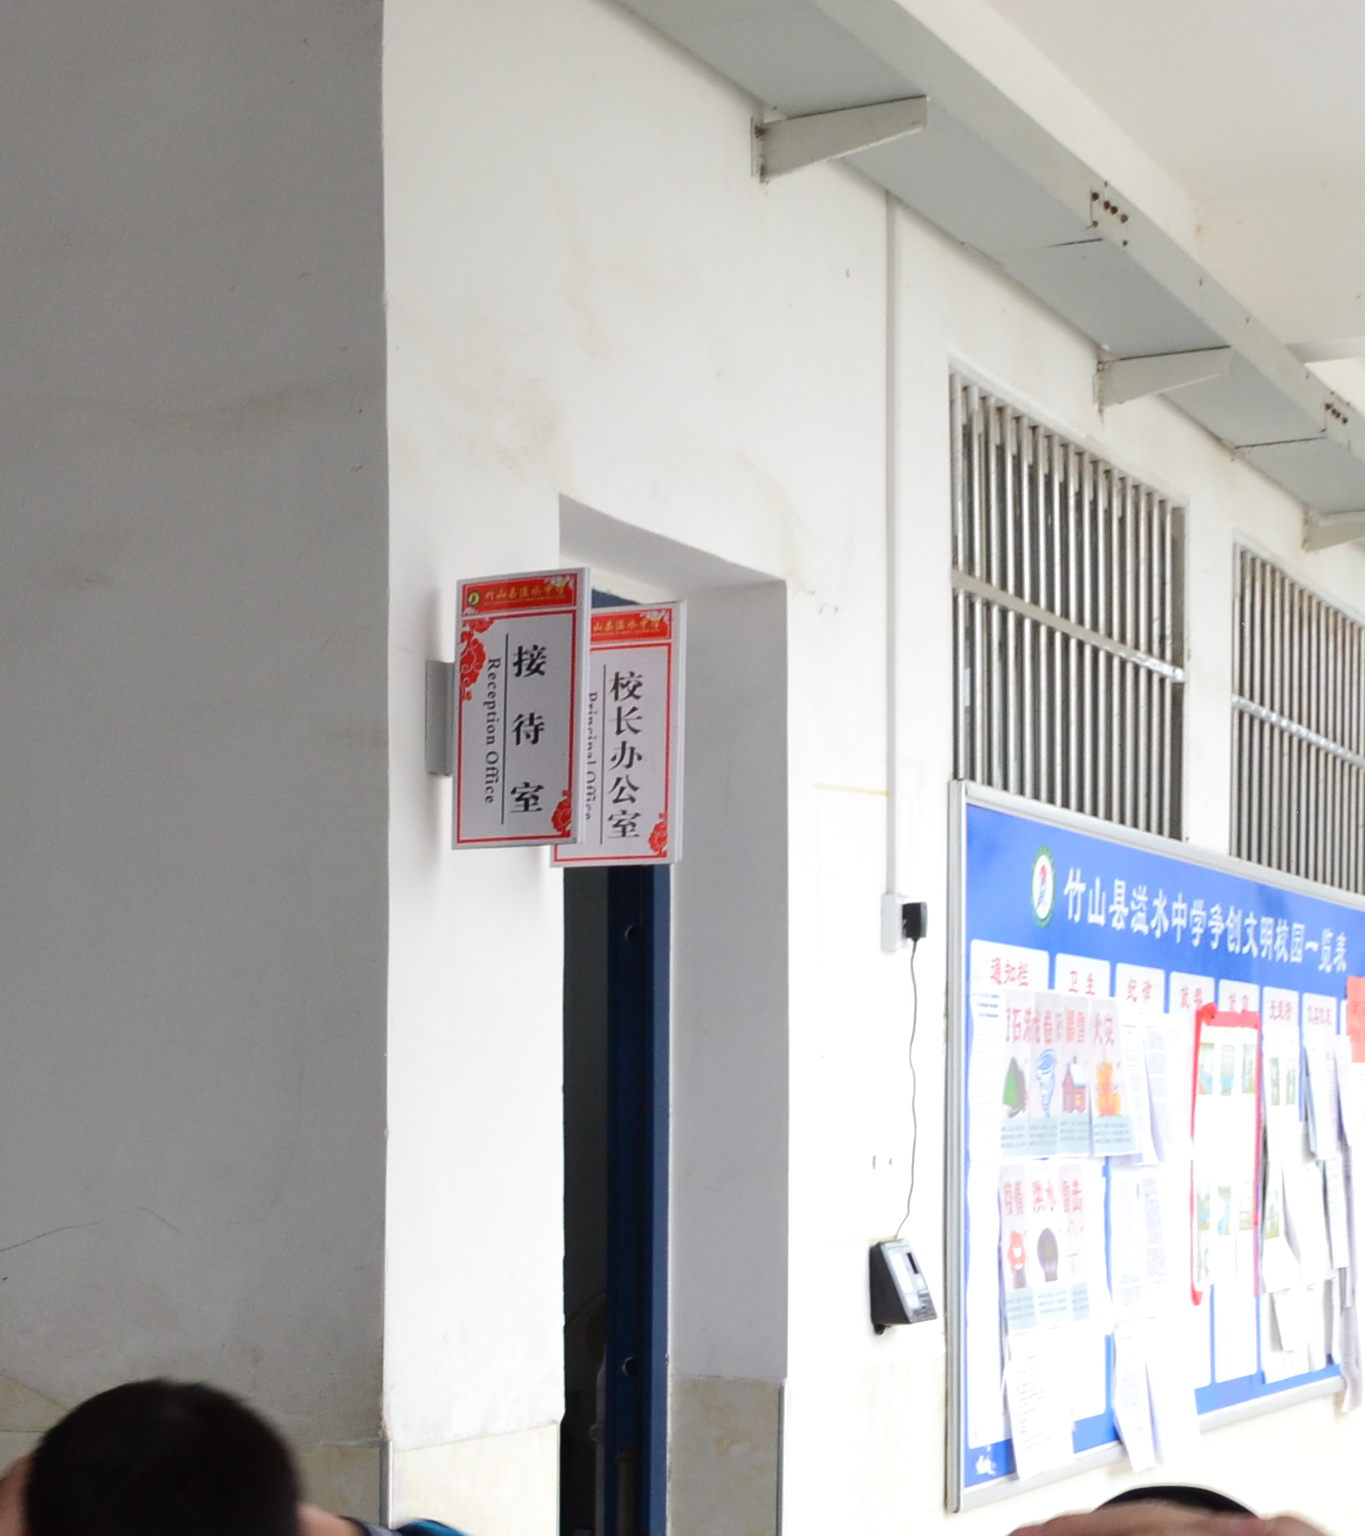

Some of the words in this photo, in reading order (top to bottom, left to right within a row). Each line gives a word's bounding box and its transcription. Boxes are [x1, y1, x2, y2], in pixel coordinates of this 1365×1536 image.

[483, 657, 501, 746] Reception
[511, 644, 548, 814] 接待室
[484, 750, 500, 804] Office
[608, 671, 643, 839] 校长办公室
[989, 957, 1029, 987] 通知栏
[1068, 970, 1096, 996] 卫生
